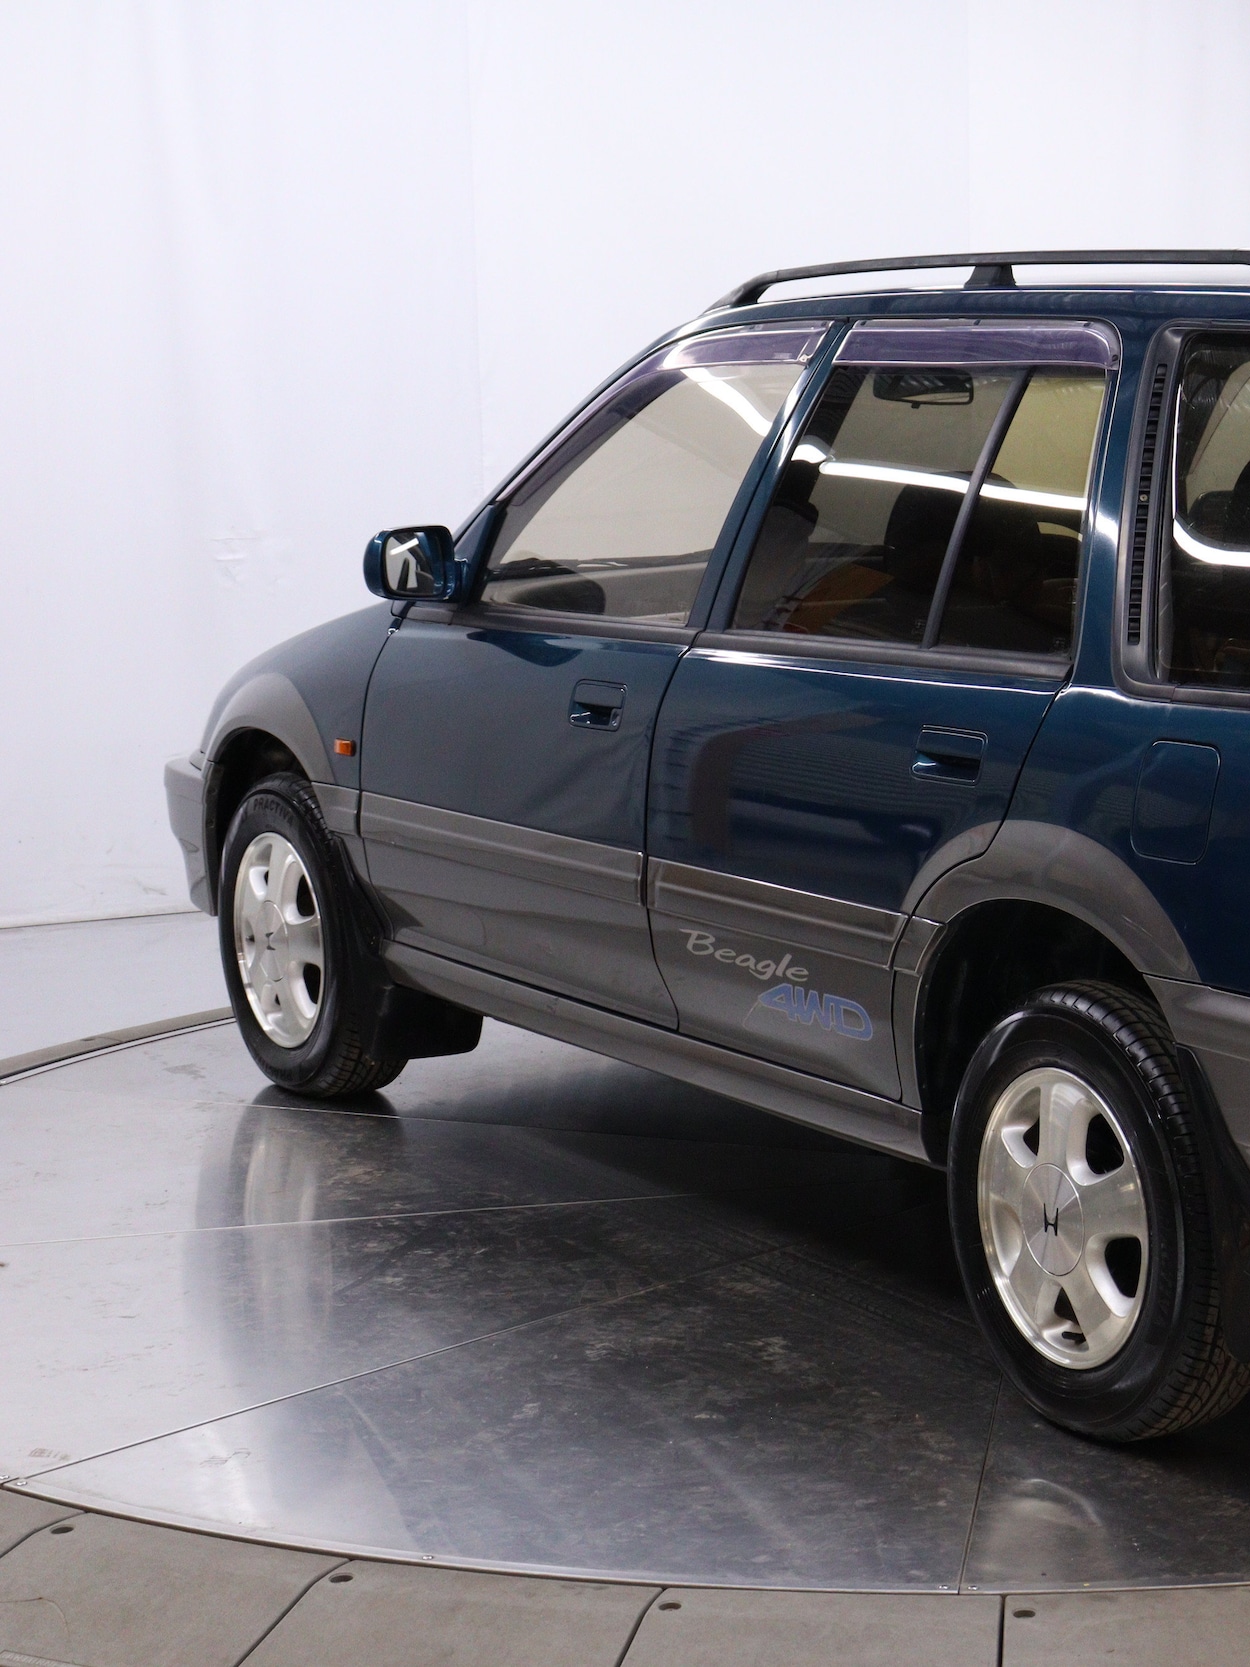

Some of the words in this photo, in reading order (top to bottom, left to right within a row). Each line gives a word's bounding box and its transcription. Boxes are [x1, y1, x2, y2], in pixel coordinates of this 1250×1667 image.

[253, 798, 294, 827] PRACTIVA
[679, 928, 809, 981] Beagle
[758, 983, 873, 1041] 4WD
